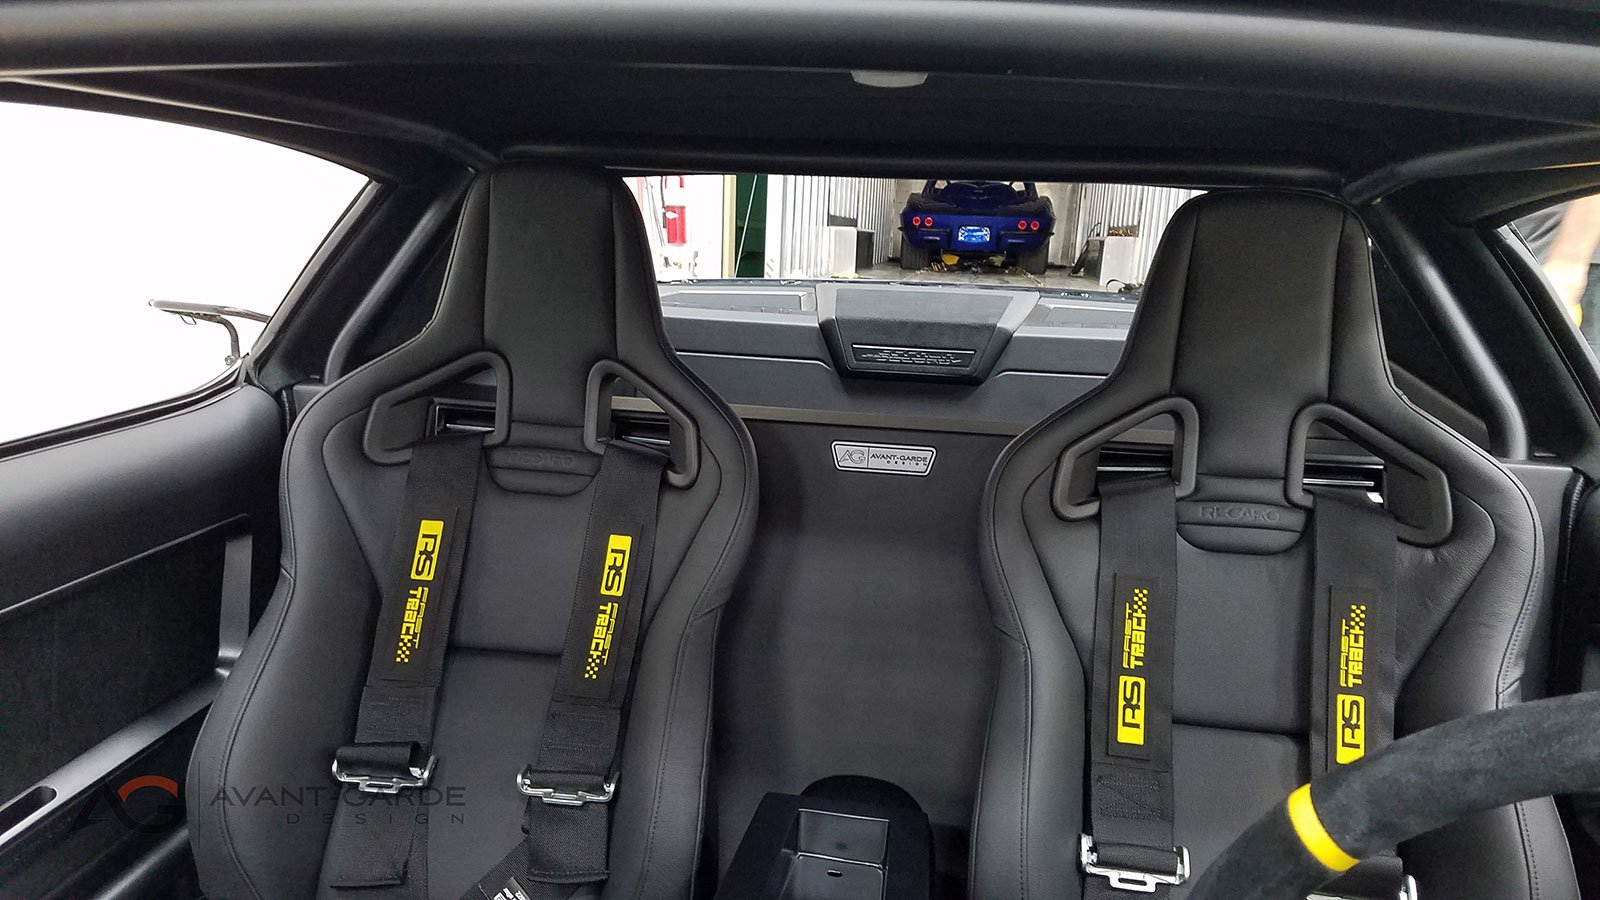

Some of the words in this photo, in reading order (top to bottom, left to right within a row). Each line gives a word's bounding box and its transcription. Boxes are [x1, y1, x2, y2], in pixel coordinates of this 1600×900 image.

[870, 453, 928, 463] AVANT-GARDE
[1199, 505, 1280, 523] RECARO
[415, 533, 438, 577] RS
[604, 548, 627, 592] RS
[1122, 680, 1141, 729] RS
[1341, 698, 1361, 749] RS
